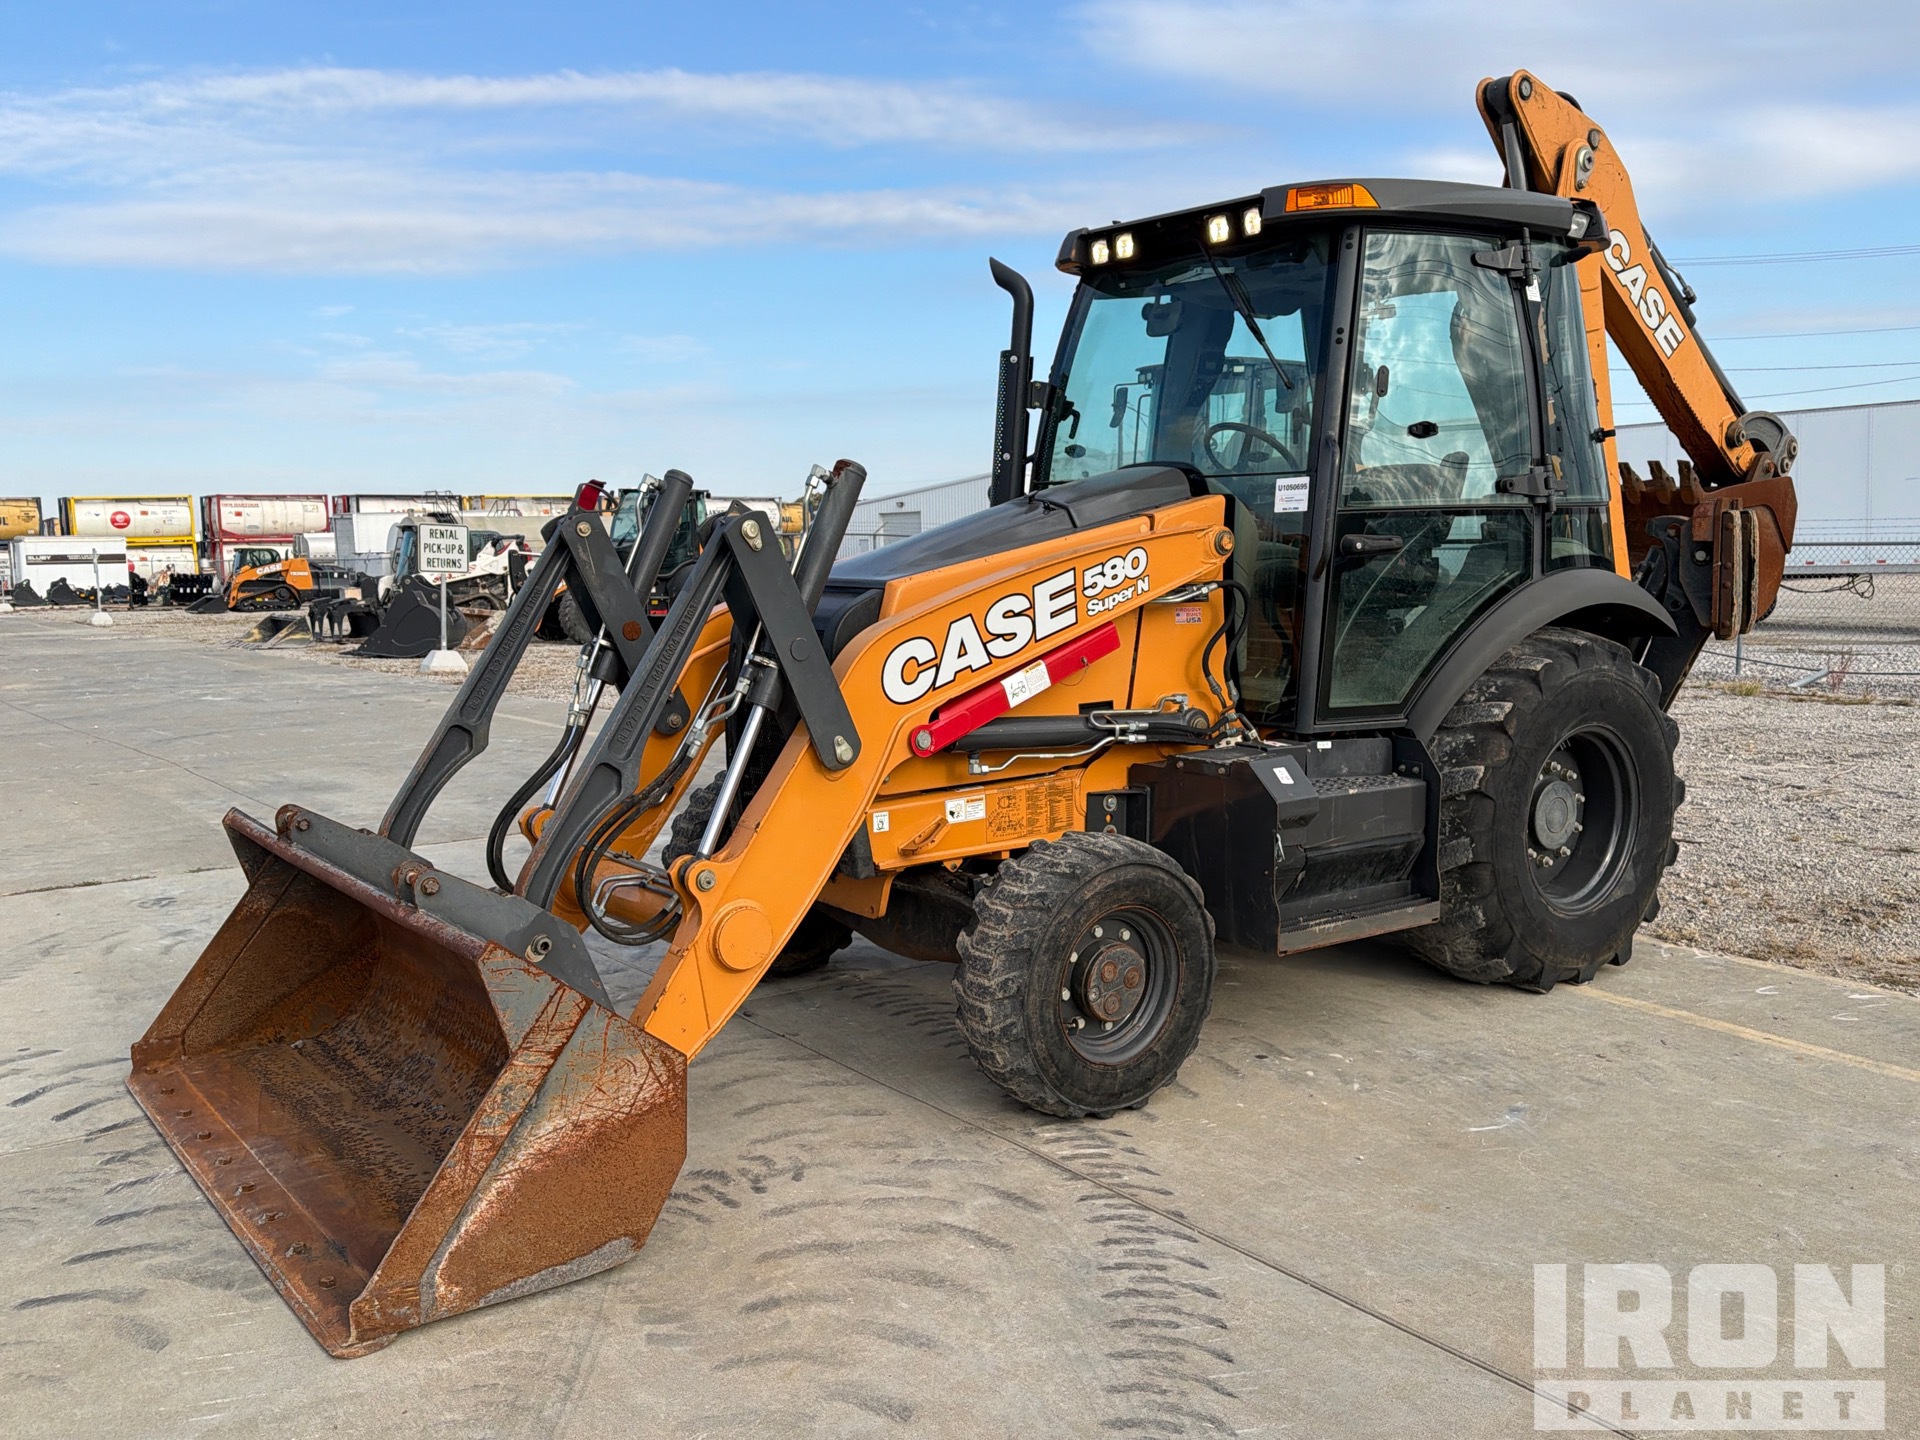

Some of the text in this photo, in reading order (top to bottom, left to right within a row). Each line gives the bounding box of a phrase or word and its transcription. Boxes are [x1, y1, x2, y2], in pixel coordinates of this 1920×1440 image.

[1603, 229, 1686, 360] CASE
[1278, 482, 1308, 492] U1050695
[429, 528, 459, 540] RENTAL
[423, 542, 465, 555] PICK-UP &
[256, 563, 283, 575] CASE
[426, 557, 462, 569] RETURNS
[1082, 546, 1149, 598] 580
[1086, 574, 1150, 617] Super N
[882, 567, 1077, 705] CASE
